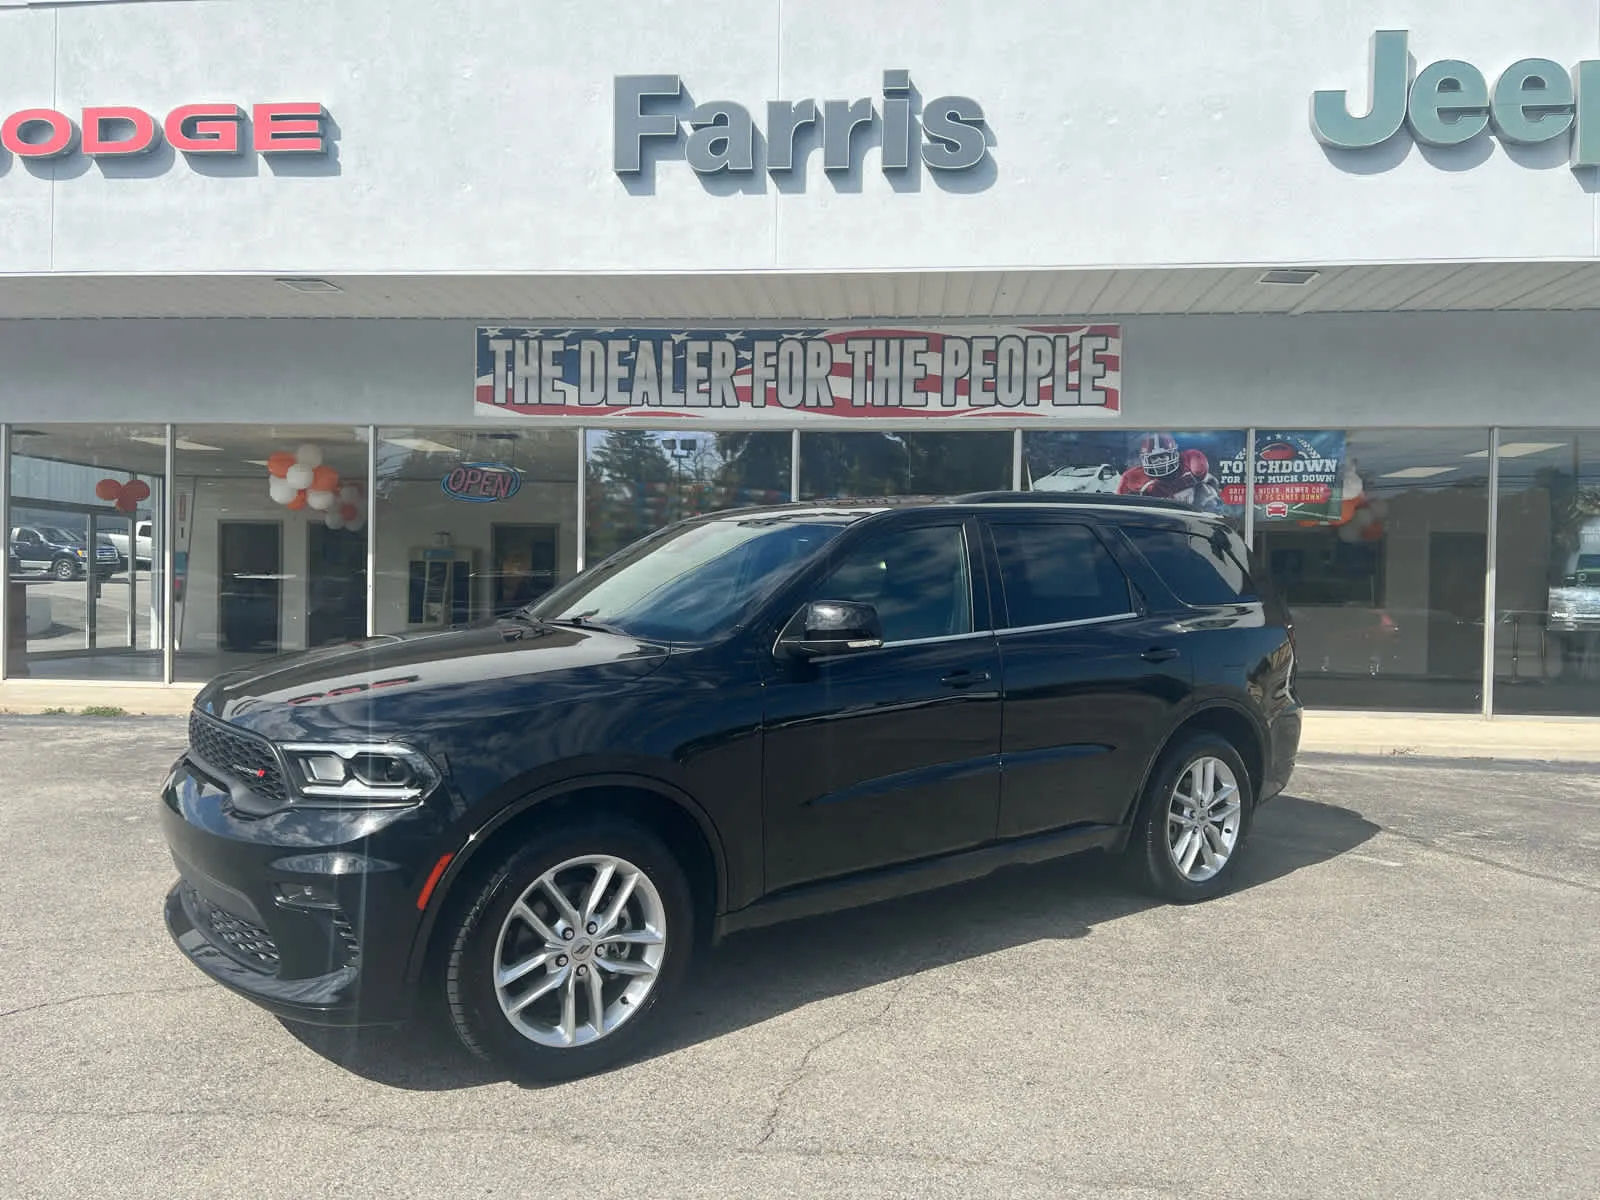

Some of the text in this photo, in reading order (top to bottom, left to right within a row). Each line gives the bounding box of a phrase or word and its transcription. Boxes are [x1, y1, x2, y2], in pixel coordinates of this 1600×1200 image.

[613, 70, 991, 175] Farris
[488, 335, 1108, 409] THE DEALER FOR THE PEOPLE
[1219, 459, 1338, 474] TOCHDOWN
[1220, 475, 1241, 484] FOR
[1267, 475, 1298, 483] MUCH
[1302, 474, 1336, 483] DOWN!
[448, 467, 513, 498] OPEN
